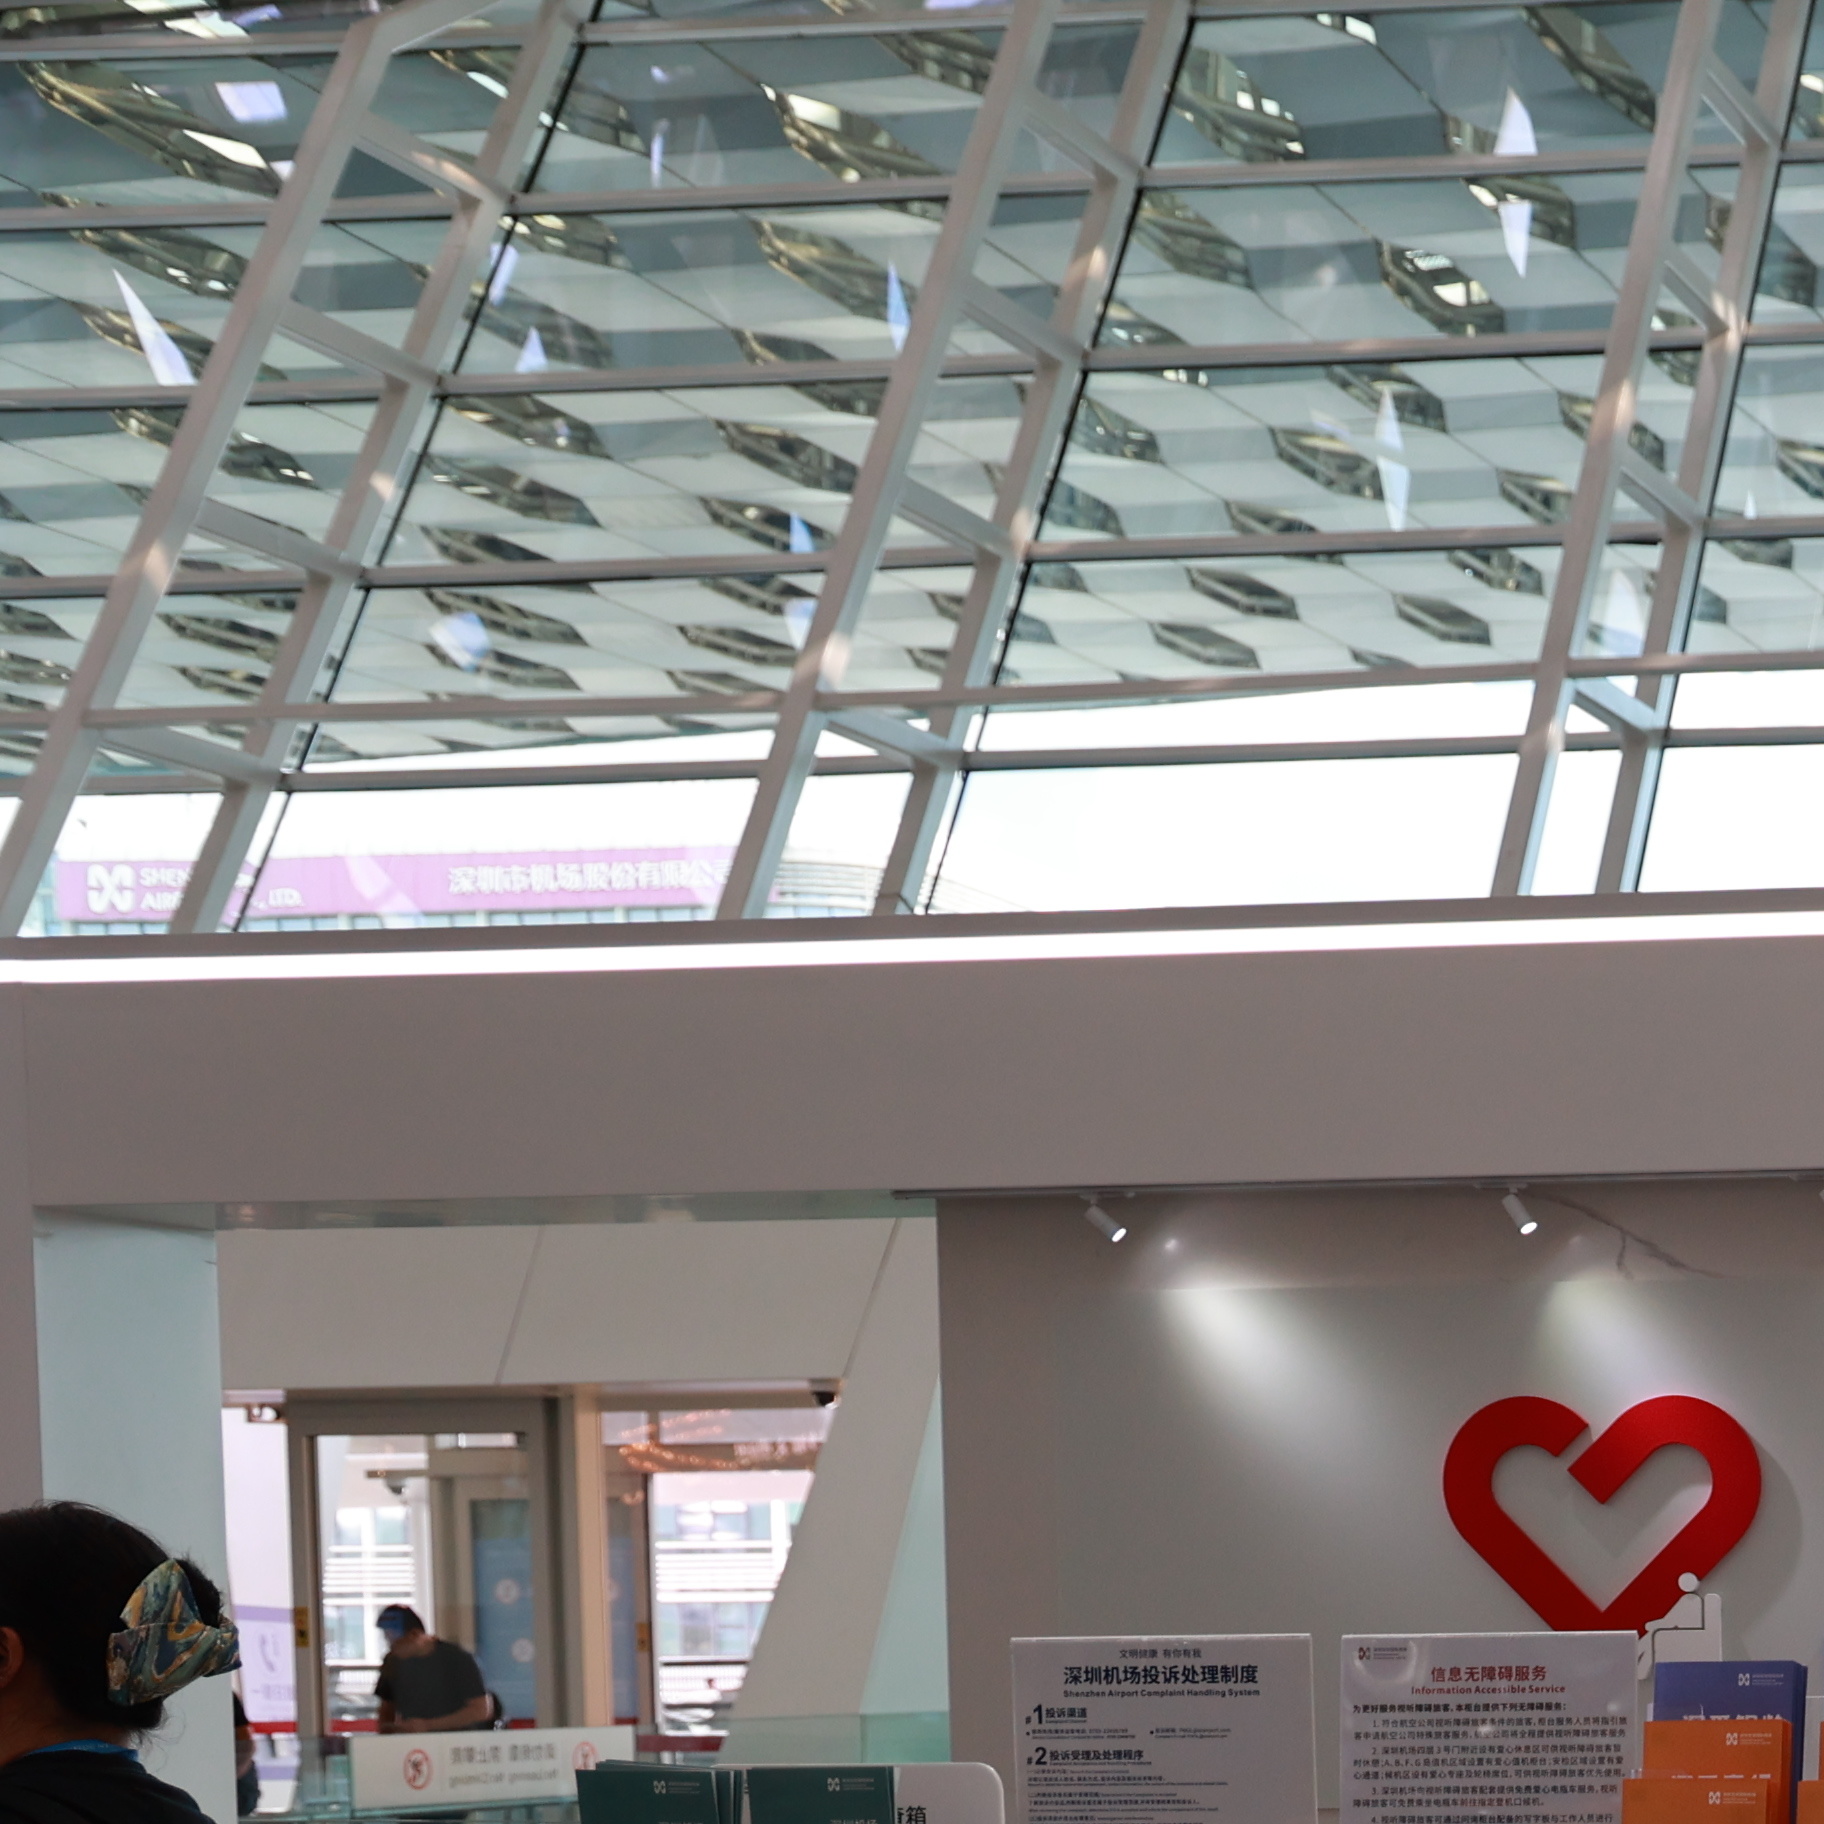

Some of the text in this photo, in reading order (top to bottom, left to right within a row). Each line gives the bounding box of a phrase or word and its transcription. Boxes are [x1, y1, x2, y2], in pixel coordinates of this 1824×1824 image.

[1063, 1664, 1259, 1685] 深圳机场投诉处理制度
[1431, 1665, 1547, 1682] 信息无障碍服务
[1063, 1689, 1260, 1698] Shenzhen Airport Complaint Handling System
[1412, 1685, 1565, 1695] Information Accessible Service
[1045, 1707, 1088, 1719] 投诉渠道
[1049, 1749, 1144, 1761] 投诉受理及处理程序
